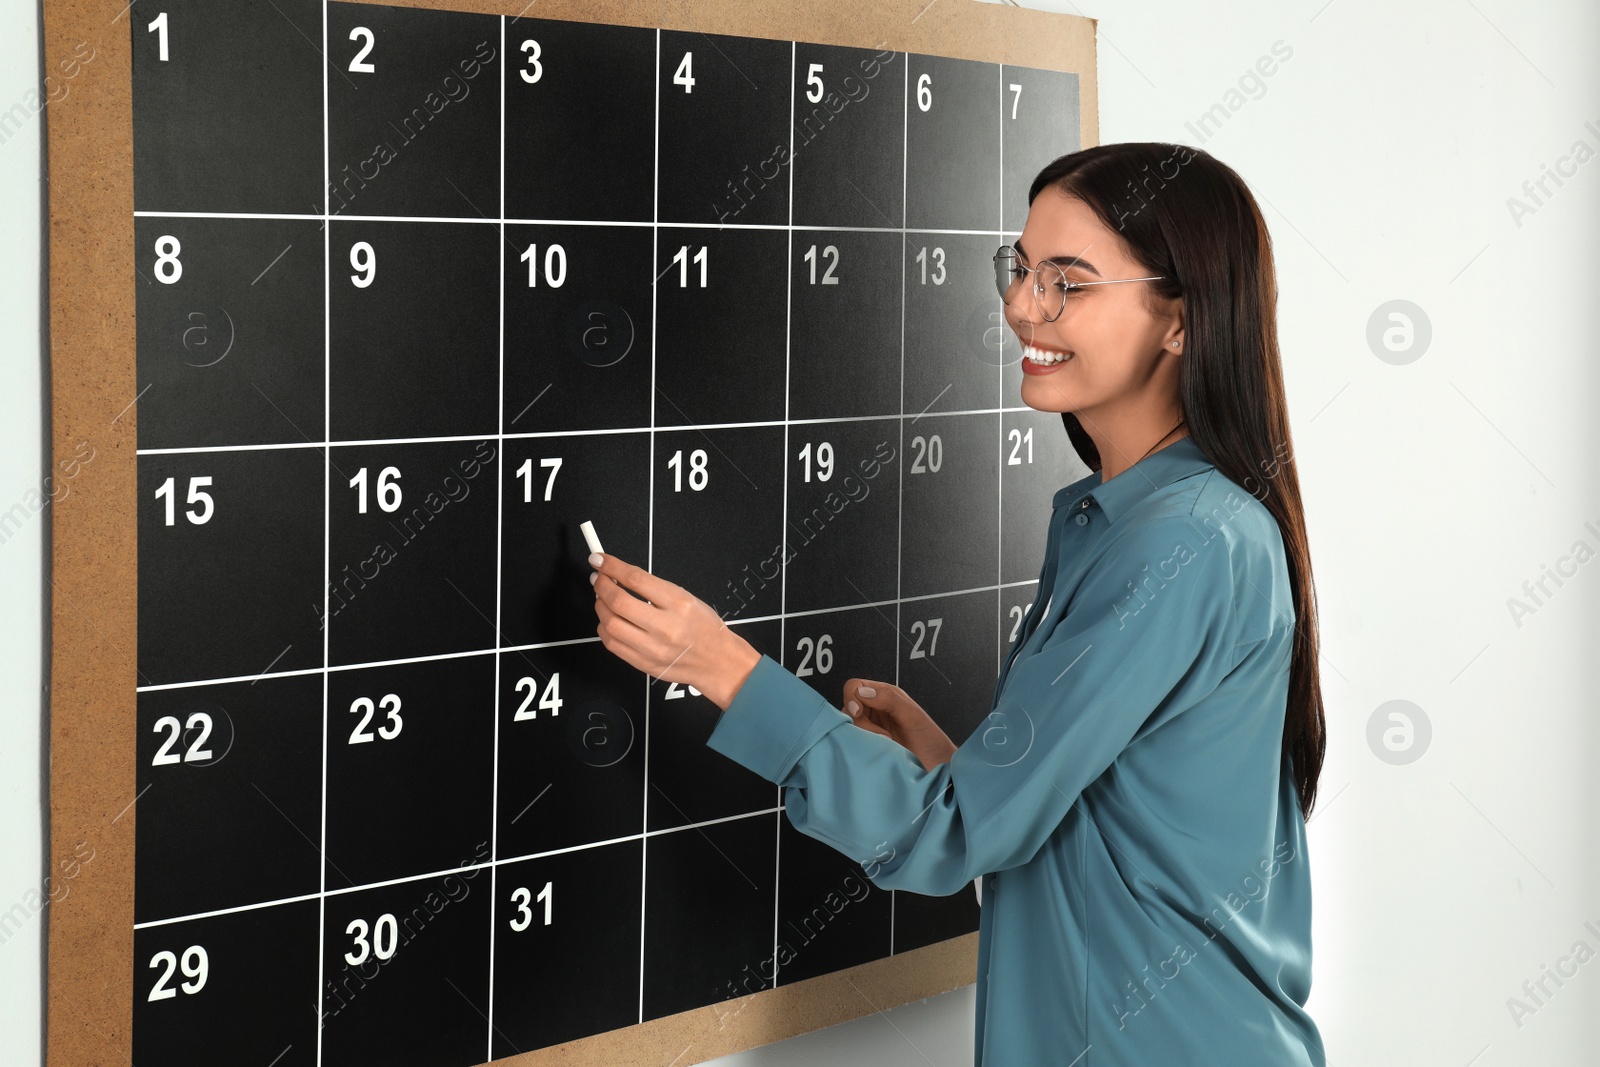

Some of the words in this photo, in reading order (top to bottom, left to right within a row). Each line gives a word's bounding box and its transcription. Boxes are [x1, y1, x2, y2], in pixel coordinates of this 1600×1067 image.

[149, 13, 168, 61] 1
[349, 27, 374, 73] 2
[520, 40, 543, 84] 3
[673, 52, 695, 93] 4
[807, 63, 823, 104] 5
[916, 74, 932, 112] 6
[1010, 83, 1022, 119] 7
[154, 235, 183, 284] 8
[350, 242, 376, 288] 9
[520, 243, 567, 288] 10
[672, 246, 708, 288] 11
[804, 245, 839, 285] 12
[916, 247, 947, 285] 13
[799, 442, 834, 483] 19
[910, 435, 943, 474] 20
[1008, 428, 1033, 466] 21
[349, 467, 403, 514] 16
[516, 458, 562, 503] 17
[668, 450, 708, 493] 18
[155, 477, 214, 527] 15
[910, 618, 943, 660] 27
[1009, 603, 1033, 642] 2
[796, 634, 833, 677] 26
[349, 694, 403, 745] 23
[513, 673, 563, 722] 24
[152, 713, 213, 767] 22
[510, 882, 553, 932] 31
[345, 914, 398, 966] 30
[148, 946, 209, 1002] 29
